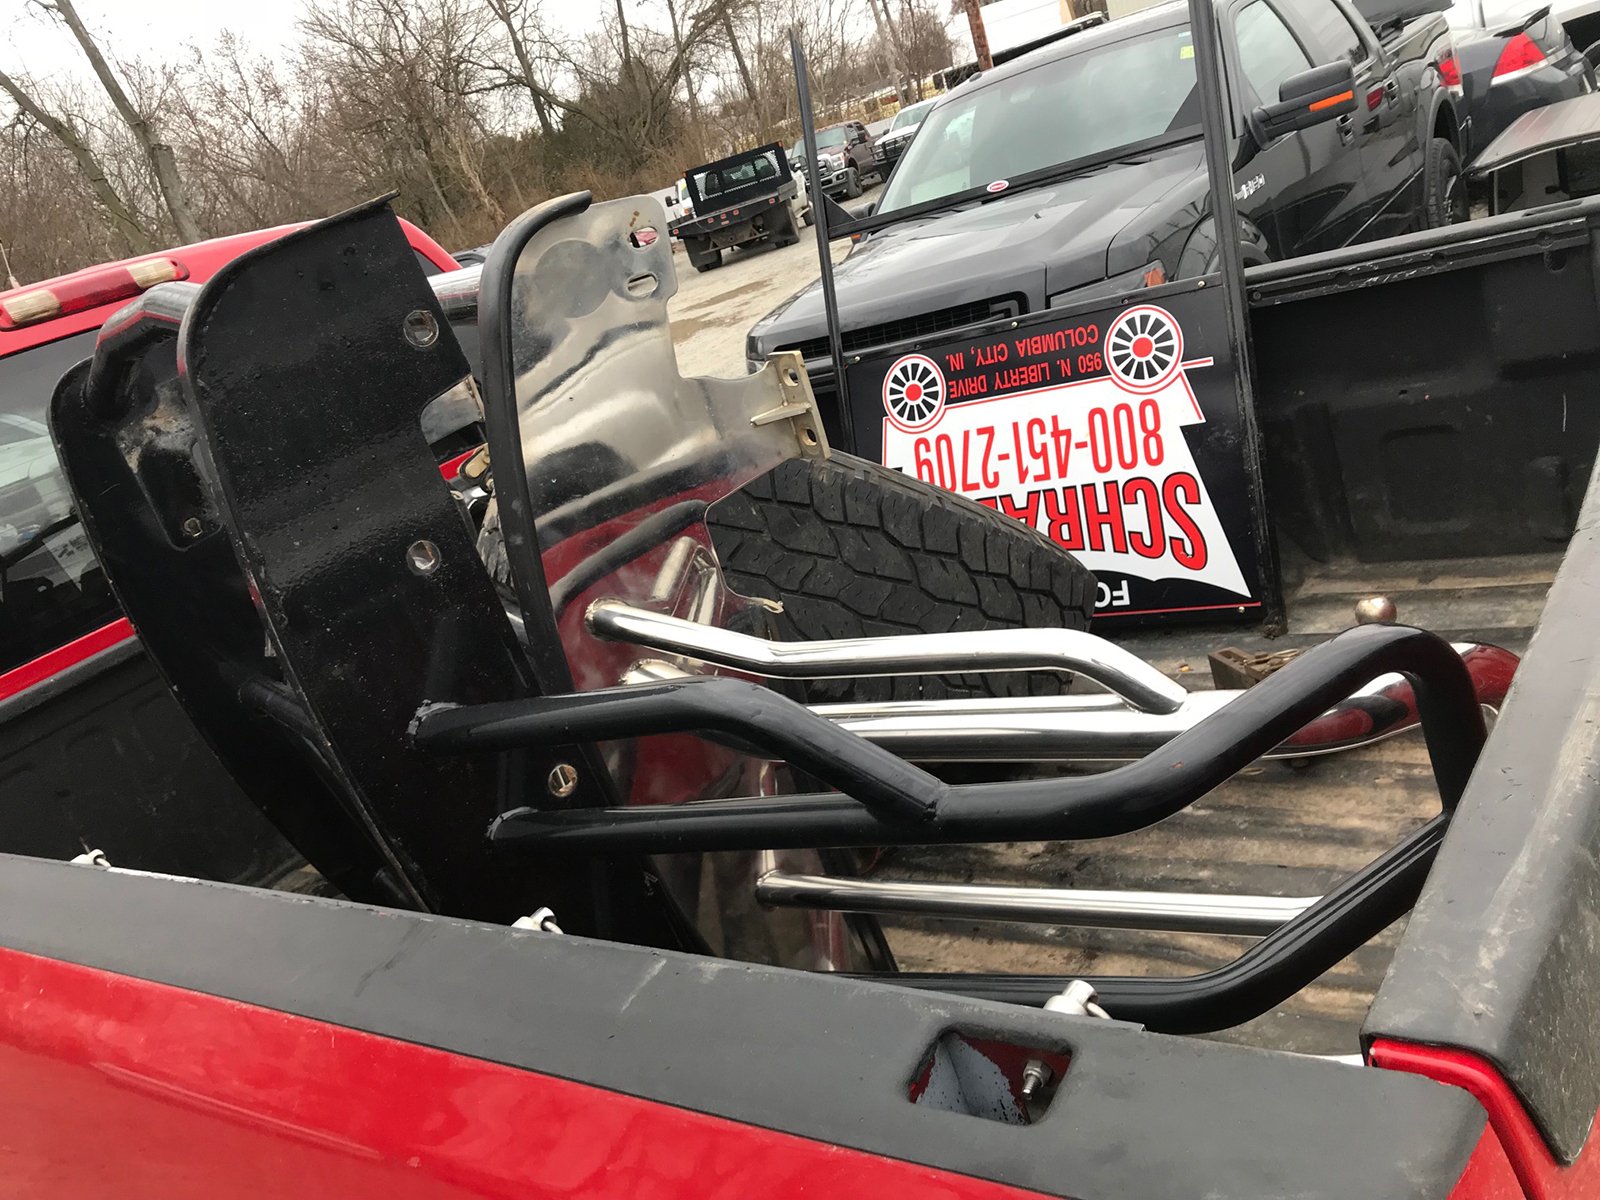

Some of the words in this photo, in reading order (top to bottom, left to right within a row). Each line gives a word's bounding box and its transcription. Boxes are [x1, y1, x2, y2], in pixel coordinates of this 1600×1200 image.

[1016, 324, 1099, 356] COLUMBIA
[945, 352, 964, 371] IN.
[970, 343, 1008, 366] CITY,
[1078, 352, 1102, 374] 950
[994, 363, 1051, 390] LIBERTY
[1056, 358, 1071, 376] N.
[948, 374, 987, 398] DRIVE
[914, 398, 1164, 492] 800-451-2709
[973, 471, 1207, 571] SCHRA
